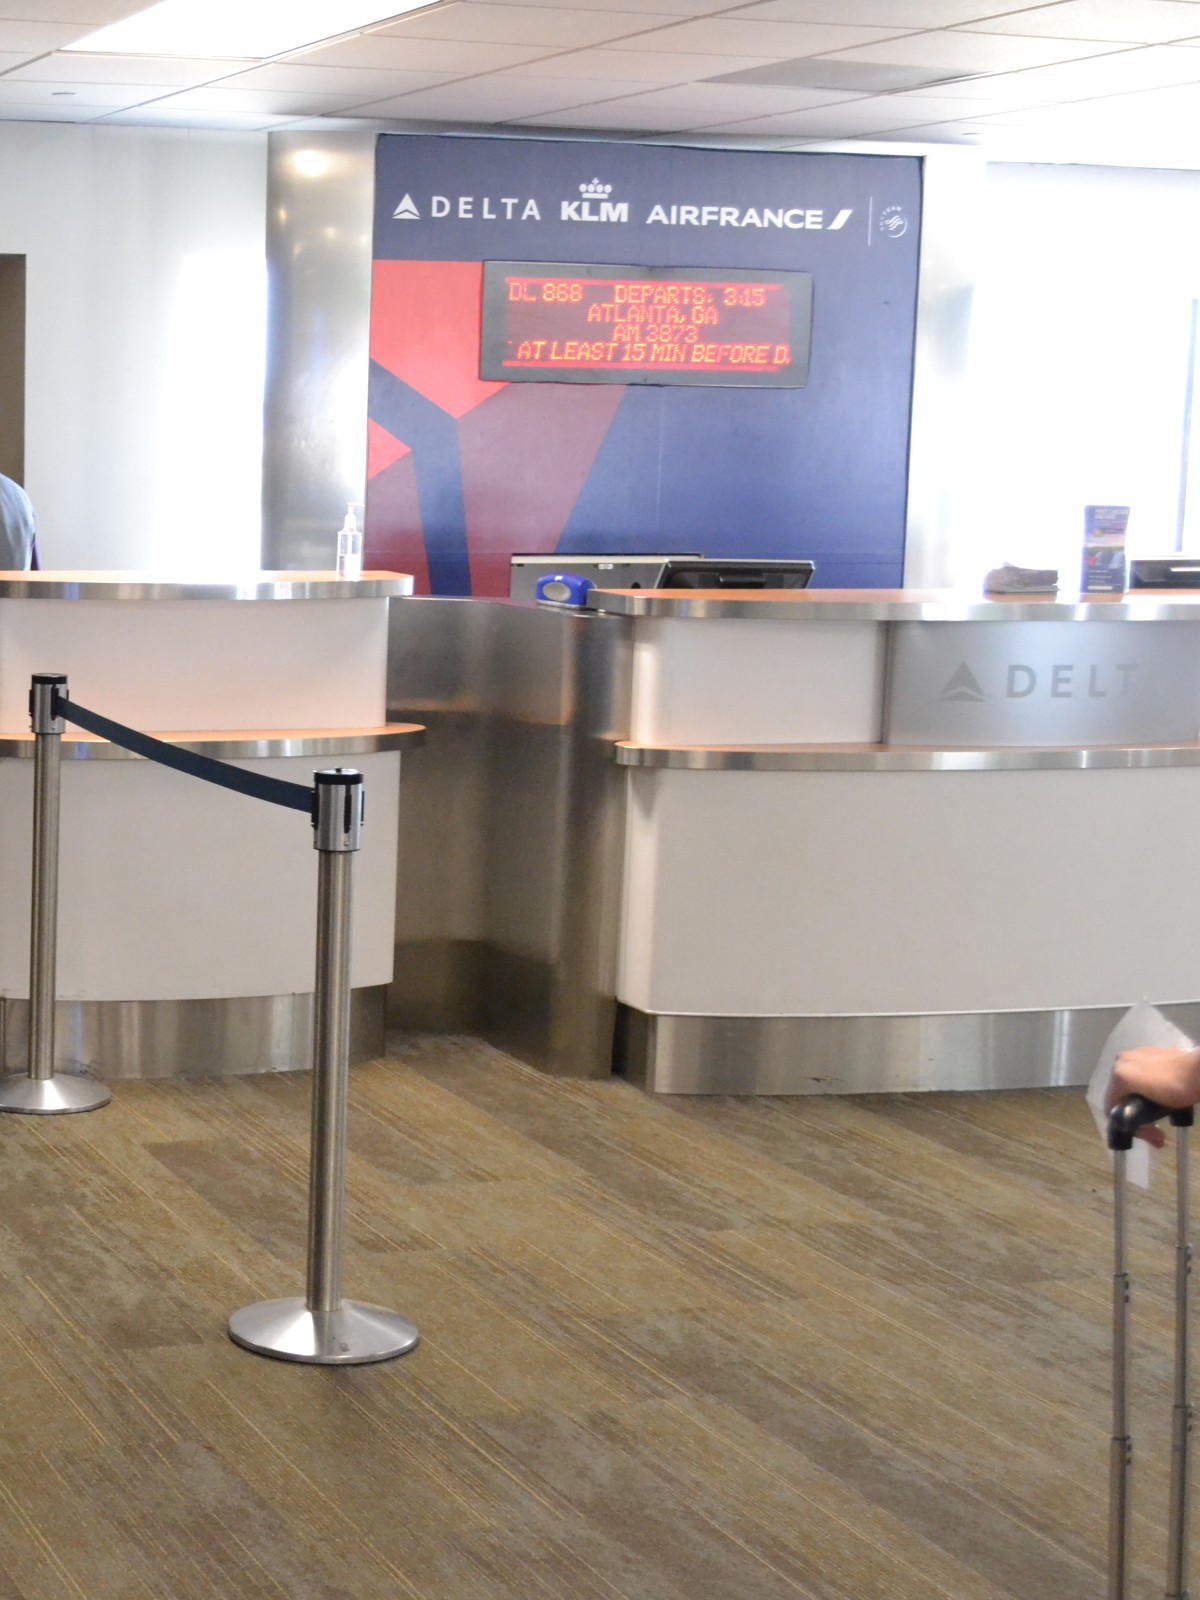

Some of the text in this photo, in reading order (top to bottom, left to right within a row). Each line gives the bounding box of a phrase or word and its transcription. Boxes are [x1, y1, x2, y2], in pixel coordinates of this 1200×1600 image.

[431, 195, 542, 221] DELTA
[560, 200, 629, 223] KLM
[645, 204, 824, 231] AIRFRANCE
[508, 282, 536, 301] DL
[542, 282, 584, 302] 868
[691, 305, 720, 325] GA
[613, 324, 641, 343] AM
[516, 341, 547, 361] AT
[550, 341, 618, 362] LEAST
[621, 343, 645, 362] 15
[649, 343, 686, 363] MIN
[690, 344, 771, 365] BEFORE
[1006, 664, 1145, 698] DELT
